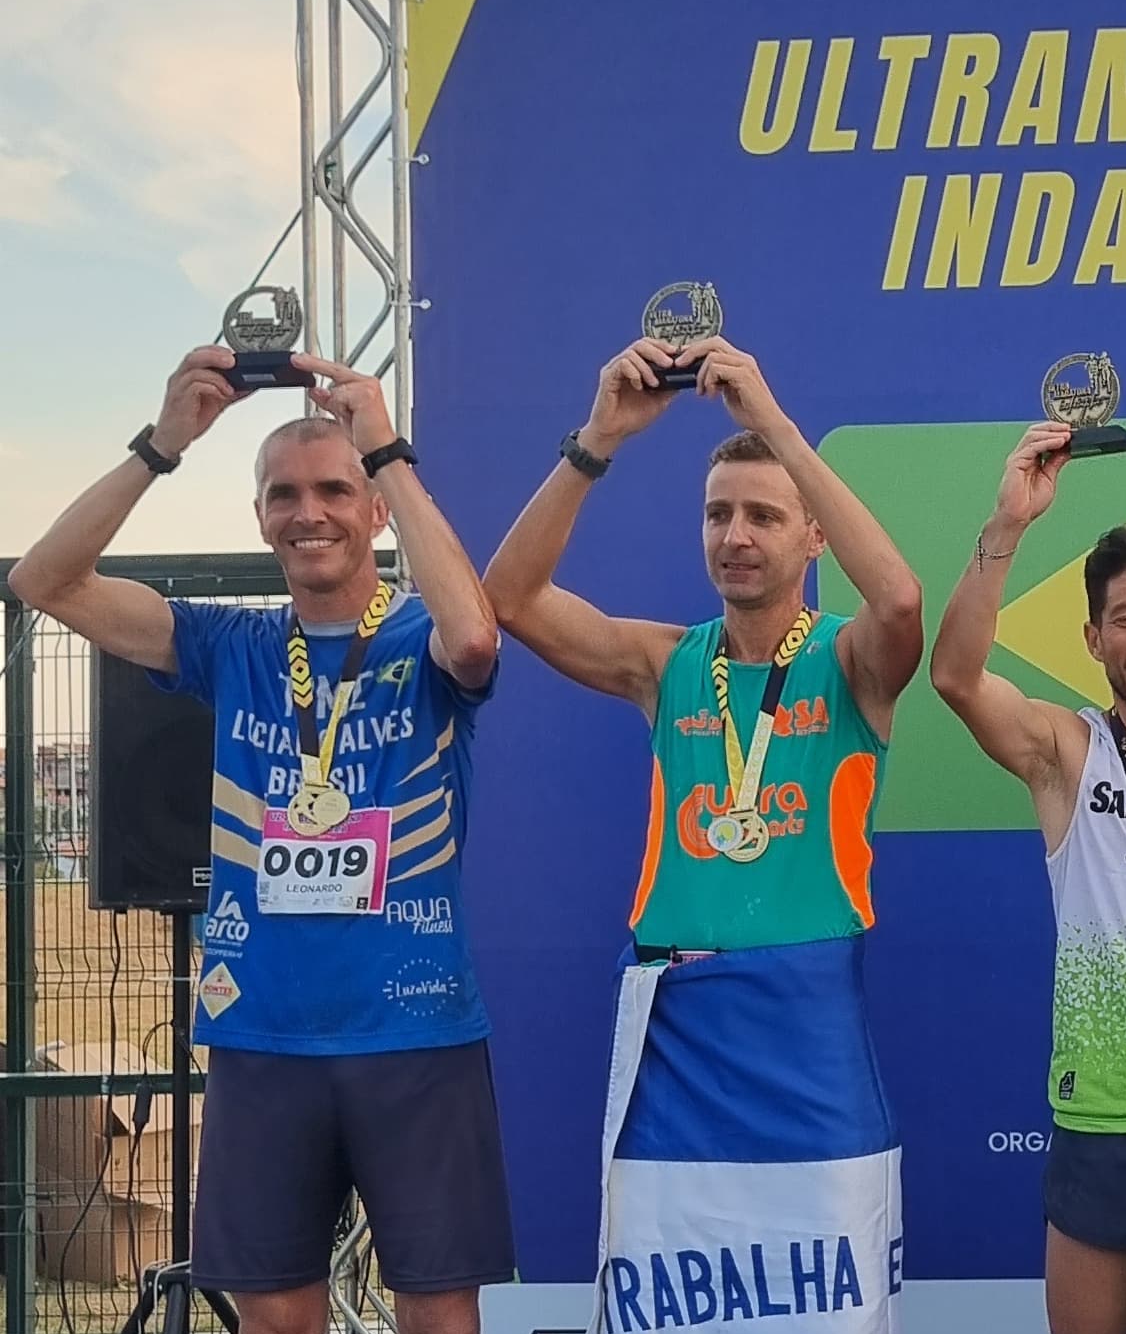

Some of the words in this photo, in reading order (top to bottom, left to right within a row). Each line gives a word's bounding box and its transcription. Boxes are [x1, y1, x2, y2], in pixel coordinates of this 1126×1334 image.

[278, 670, 374, 719] TME
[339, 706, 414, 755] ALVES
[268, 763, 367, 796] BRSIL
[264, 845, 368, 878] 0019
[286, 884, 343, 893] LEONARDO
[386, 897, 451, 924] AQUA
[205, 917, 250, 942] arco
